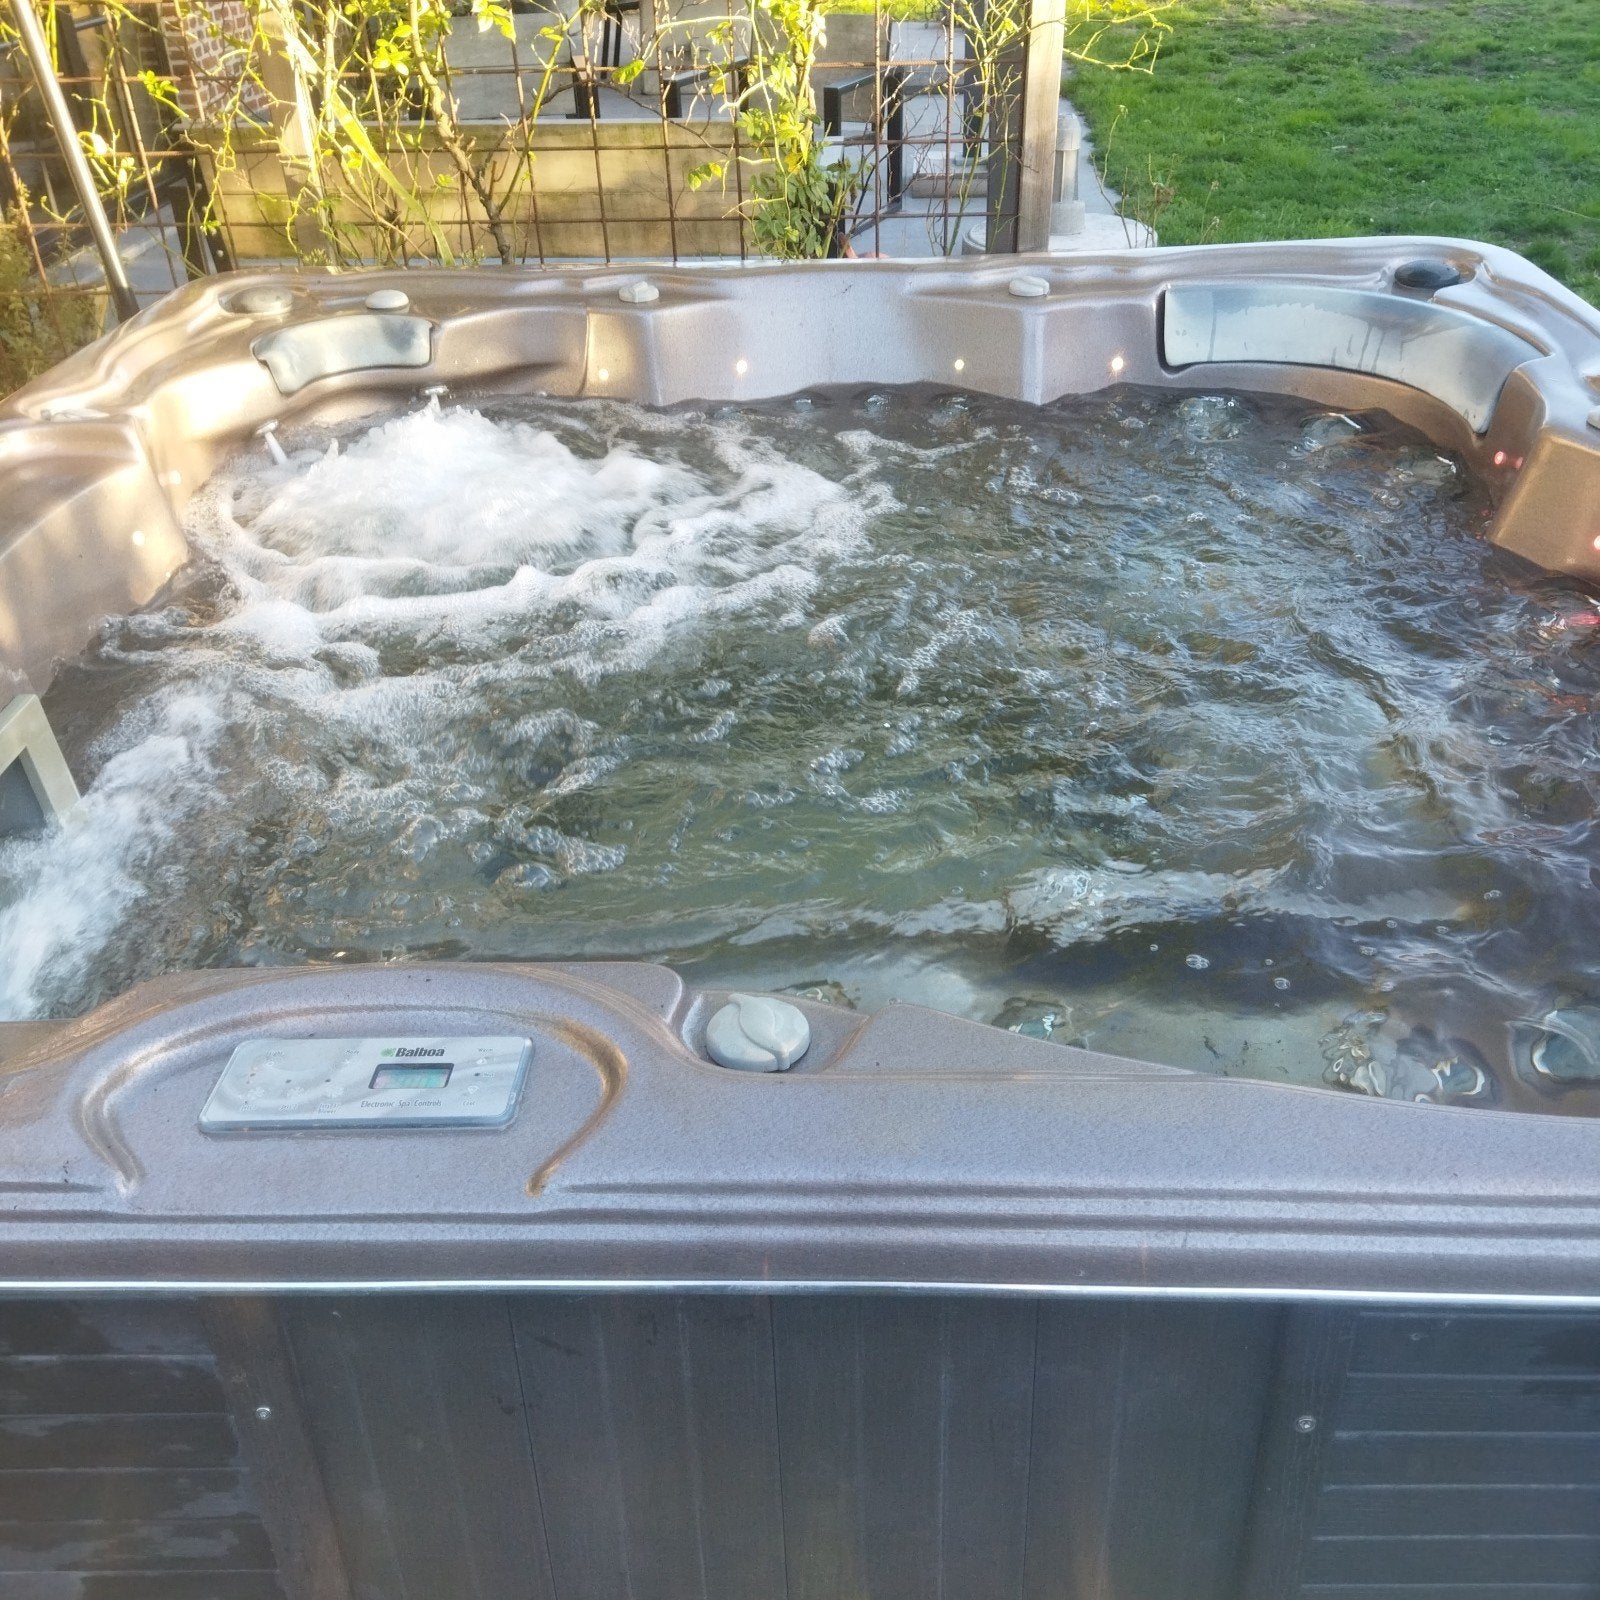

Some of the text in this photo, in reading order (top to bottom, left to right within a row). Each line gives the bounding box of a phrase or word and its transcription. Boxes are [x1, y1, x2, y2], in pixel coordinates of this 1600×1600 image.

[395, 1047, 445, 1057] Balboa
[360, 1099, 442, 1108] Electronic Spa Controls
